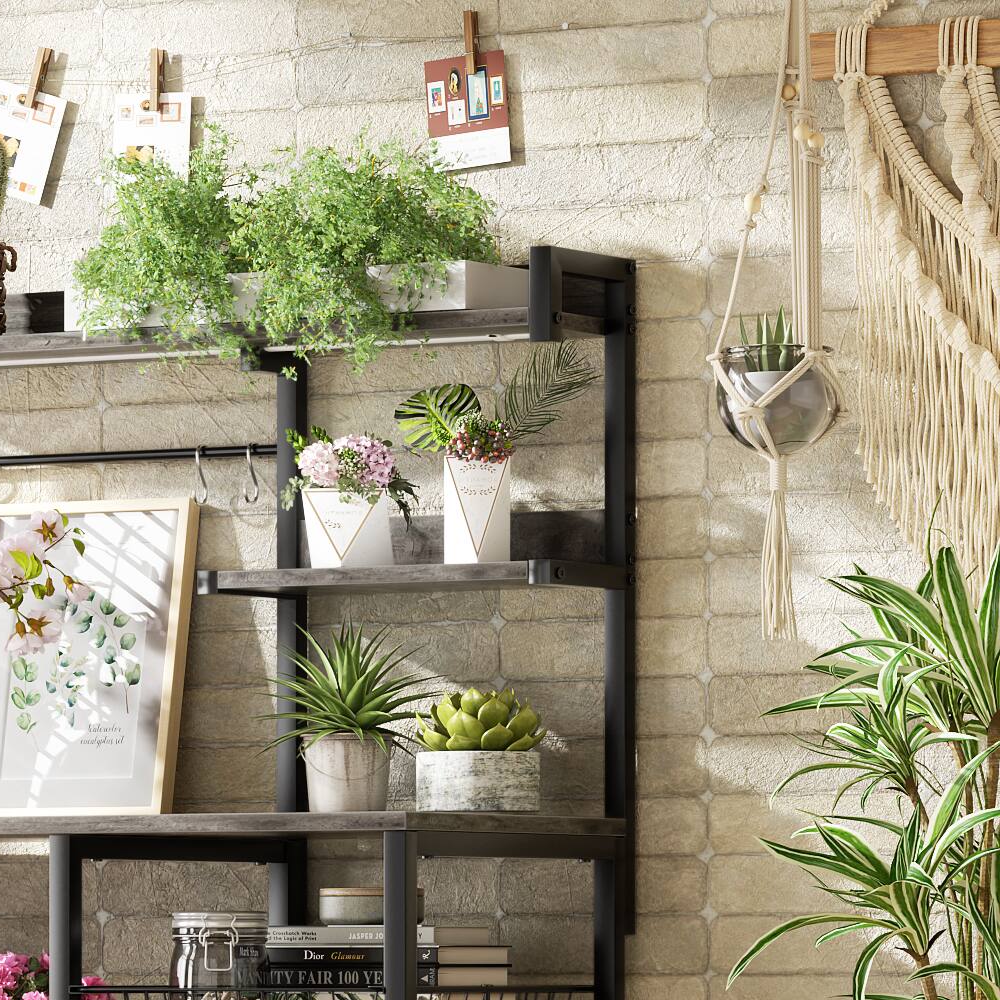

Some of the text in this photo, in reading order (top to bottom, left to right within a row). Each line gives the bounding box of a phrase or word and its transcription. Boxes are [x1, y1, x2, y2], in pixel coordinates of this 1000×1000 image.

[348, 932, 384, 940] JASPER JO
[303, 949, 366, 960] Dior Glamour
[298, 970, 333, 985] FAIR
[337, 970, 360, 985] 100
[362, 970, 383, 985] YE
